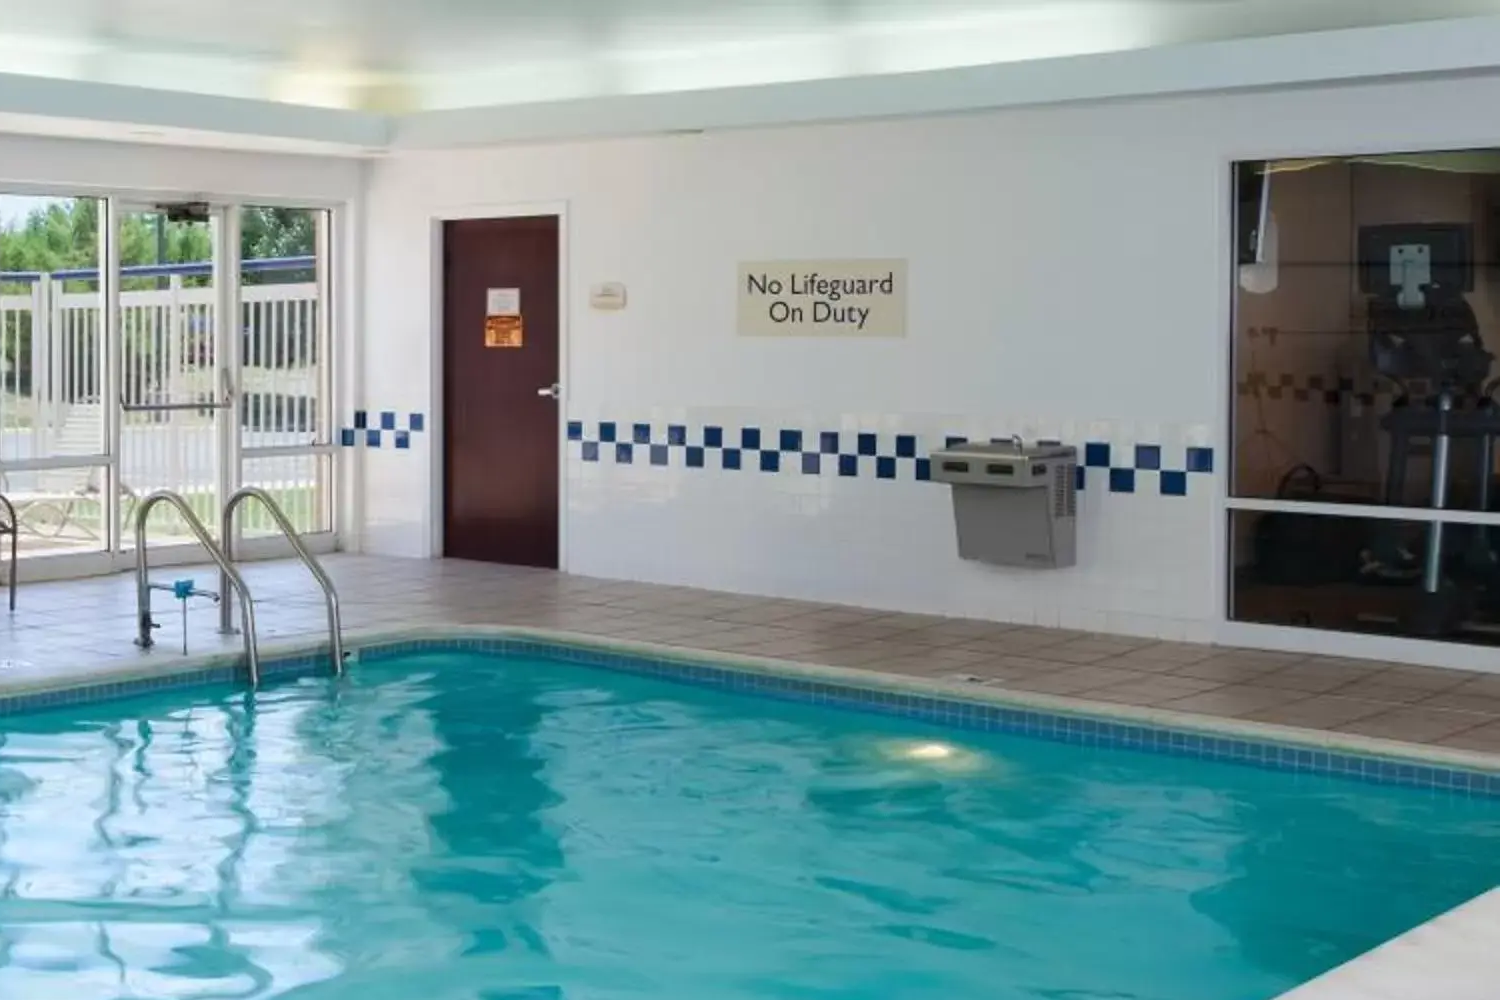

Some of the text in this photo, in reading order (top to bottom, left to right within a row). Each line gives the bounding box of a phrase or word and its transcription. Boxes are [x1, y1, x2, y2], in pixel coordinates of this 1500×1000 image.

[747, 272, 894, 301] No Lifeguard
[769, 301, 870, 330] On Duty
